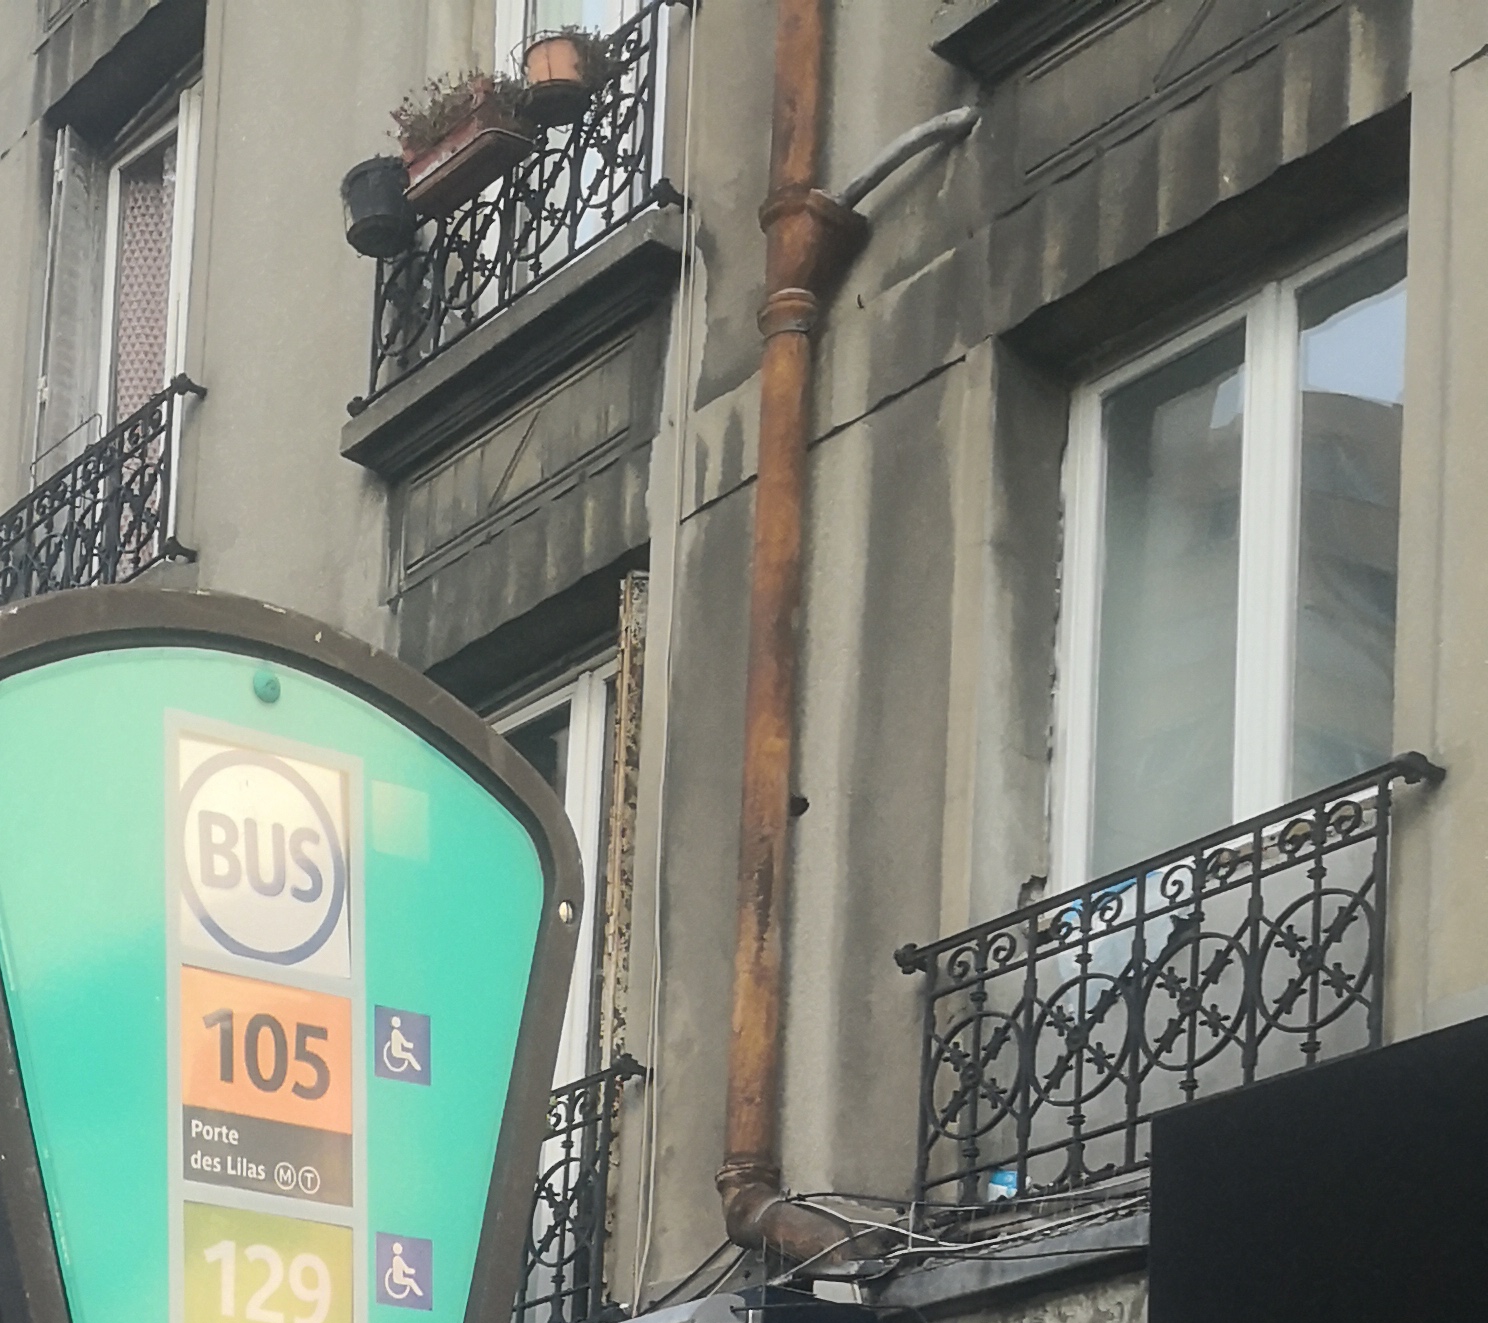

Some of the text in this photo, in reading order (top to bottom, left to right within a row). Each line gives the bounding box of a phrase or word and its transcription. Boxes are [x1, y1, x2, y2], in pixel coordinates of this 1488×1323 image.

[197, 810, 323, 903] BUS
[202, 1008, 331, 1102] 105
[191, 1119, 239, 1145] Porte
[191, 1151, 221, 1173] des
[226, 1157, 266, 1180] Lilas
